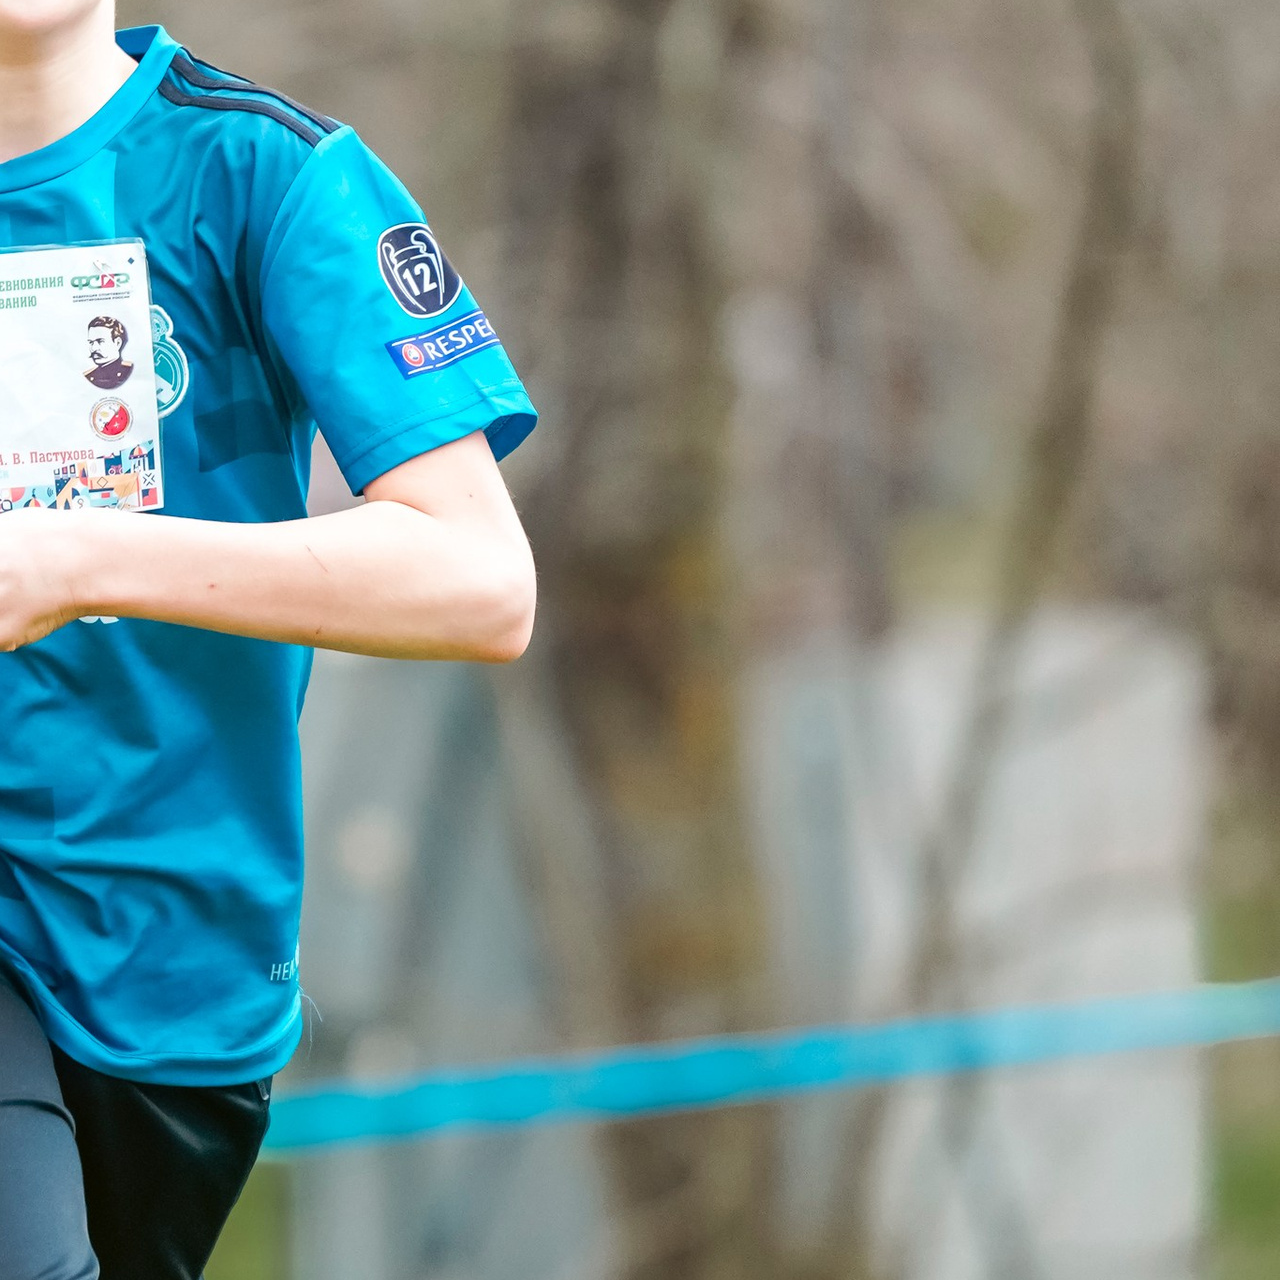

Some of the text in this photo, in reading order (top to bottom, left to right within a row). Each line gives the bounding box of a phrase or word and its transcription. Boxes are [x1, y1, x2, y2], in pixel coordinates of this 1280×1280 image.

[402, 262, 438, 297] 12
[12, 453, 26, 465] В.
[29, 449, 95, 465] Пастухова
